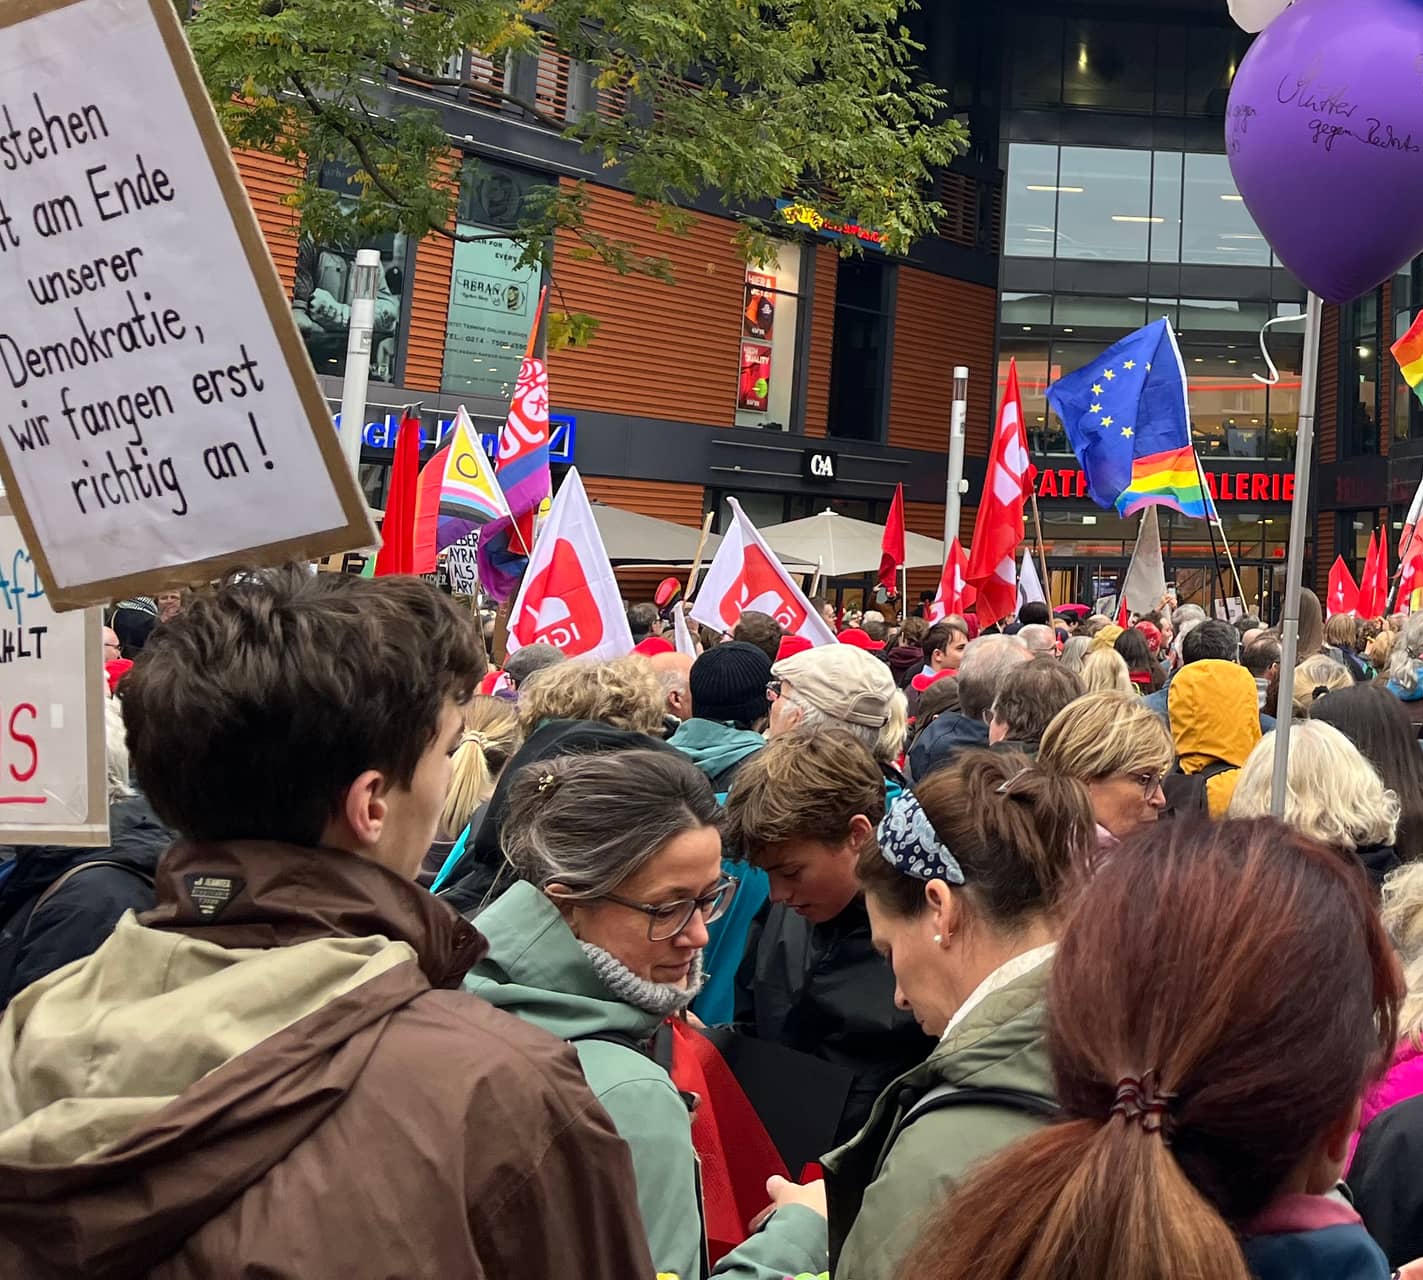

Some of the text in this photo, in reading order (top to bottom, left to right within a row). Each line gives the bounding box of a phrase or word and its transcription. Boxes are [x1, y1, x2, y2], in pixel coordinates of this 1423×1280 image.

[0, 92, 109, 170] stehen
[1308, 119, 1355, 151] gegen
[33, 195, 83, 237] am
[86, 154, 175, 222] Ende
[28, 247, 143, 305] unserer
[0, 290, 205, 389] Demokratie,
[8, 344, 264, 452] wir fangen erst
[71, 412, 274, 516] richtig an!
[455, 564, 475, 580] ALS
